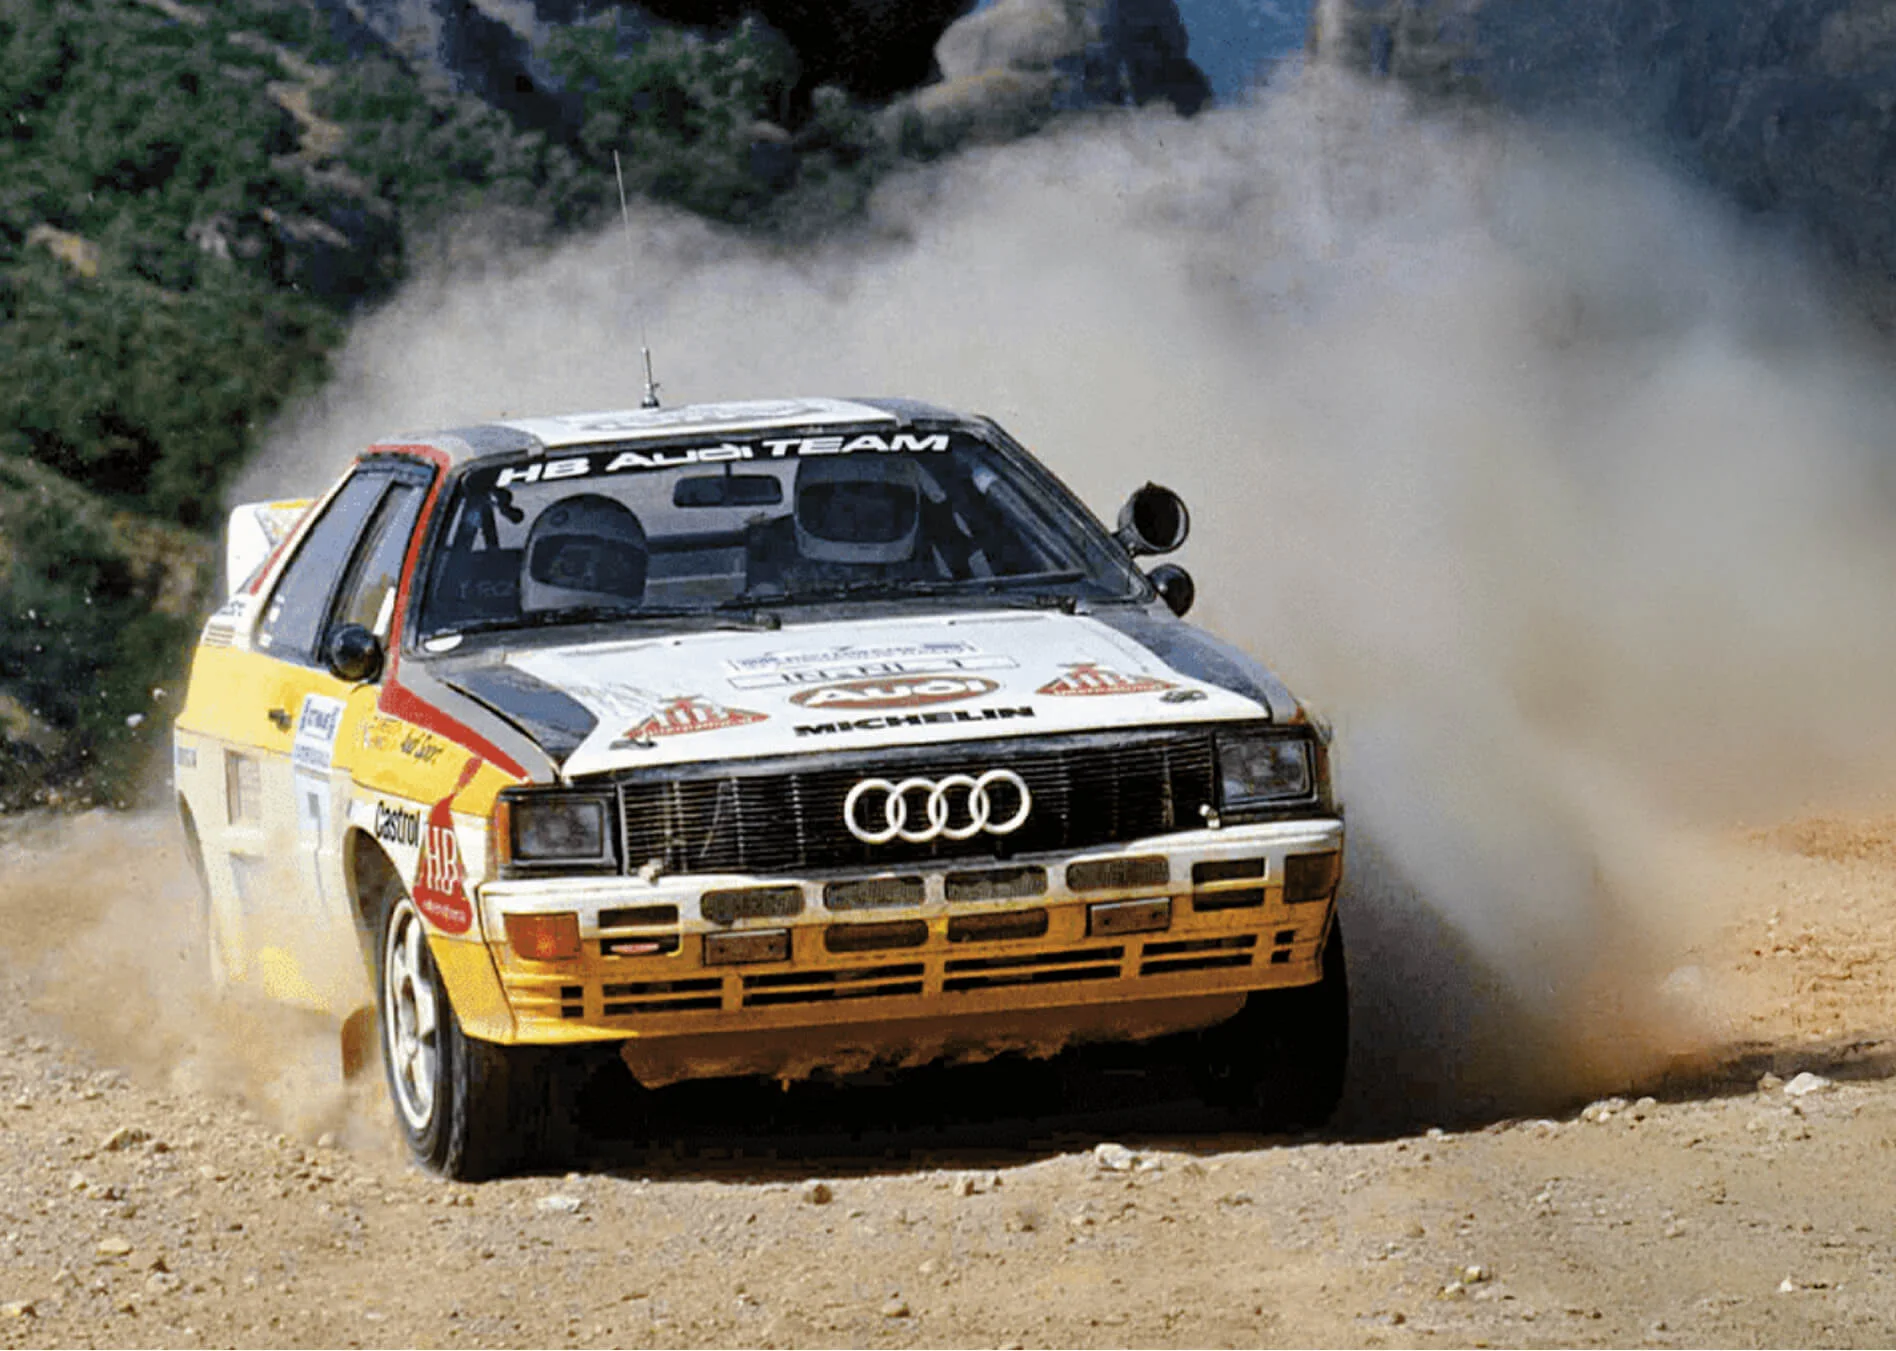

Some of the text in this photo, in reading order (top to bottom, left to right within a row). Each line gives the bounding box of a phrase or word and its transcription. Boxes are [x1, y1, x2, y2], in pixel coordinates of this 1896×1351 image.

[496, 457, 590, 488] HB
[762, 434, 949, 457] TEAM
[793, 705, 1034, 737] MICHELIN
[374, 801, 421, 848] Castrol
[425, 826, 459, 896] HB
